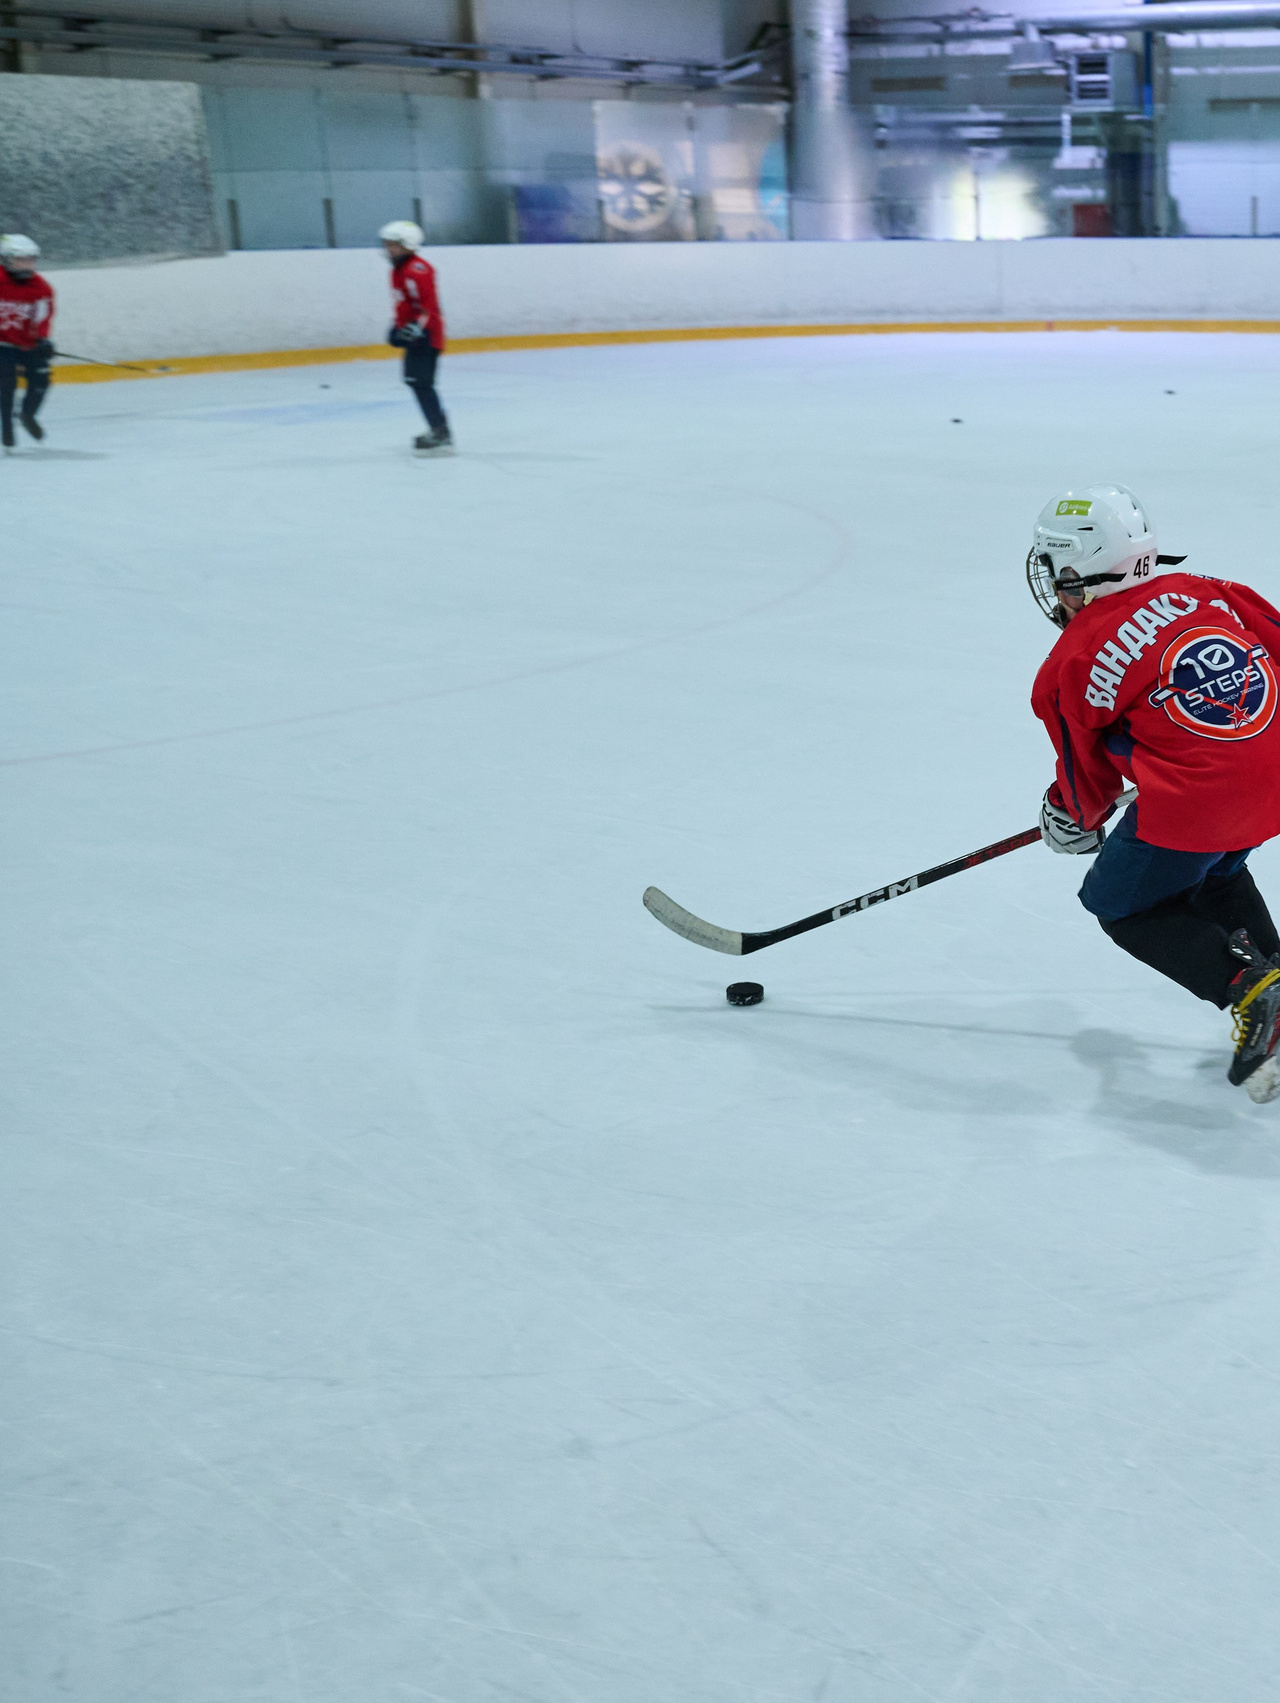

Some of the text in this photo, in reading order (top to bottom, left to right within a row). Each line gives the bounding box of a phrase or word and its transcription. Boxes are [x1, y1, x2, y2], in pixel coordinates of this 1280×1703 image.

[1133, 555, 1150, 579] 46
[1179, 643, 1235, 680] 10
[1185, 665, 1261, 708] STEPS
[831, 875, 919, 921] CCM
